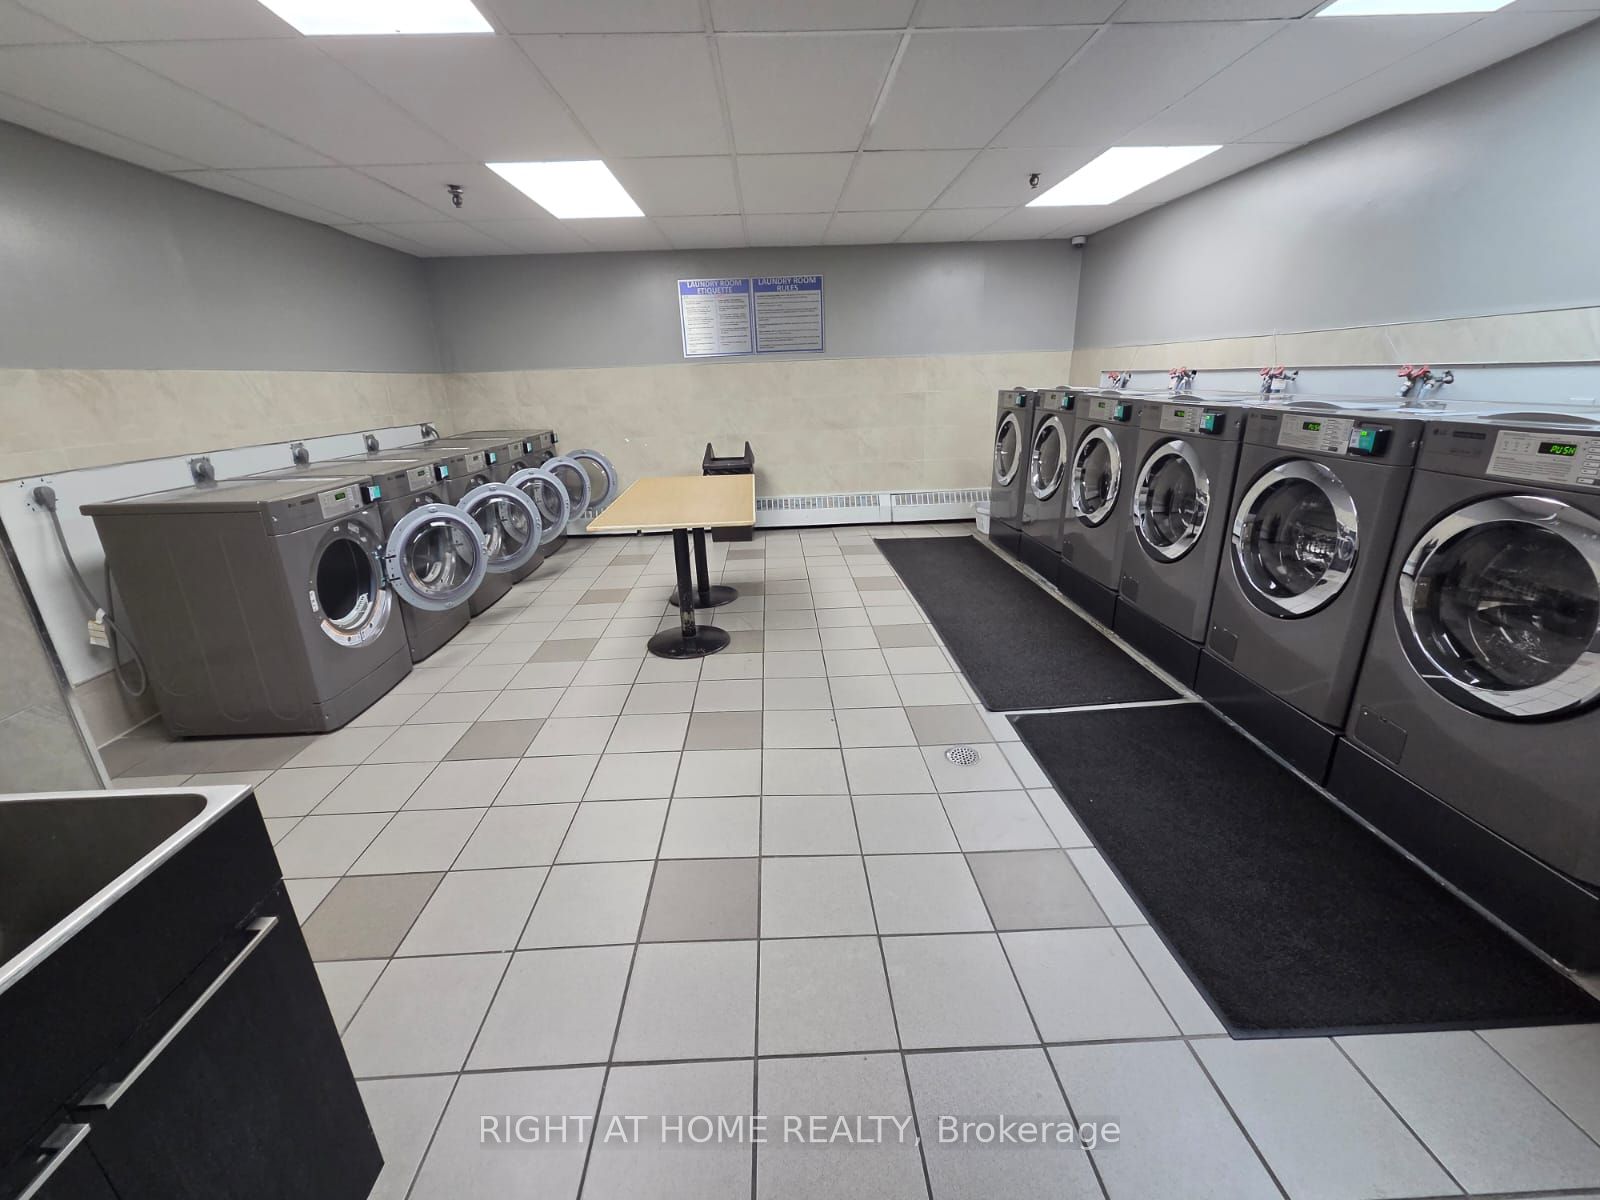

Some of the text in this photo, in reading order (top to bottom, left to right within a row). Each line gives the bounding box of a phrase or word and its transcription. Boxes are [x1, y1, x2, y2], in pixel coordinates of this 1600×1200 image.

[687, 280, 717, 288] LAUNDRY
[758, 276, 817, 286] LAUNDRY ROOM
[697, 287, 733, 295] ETIQUETTE
[777, 284, 799, 292] RULES
[1549, 445, 1576, 454] PUSH
